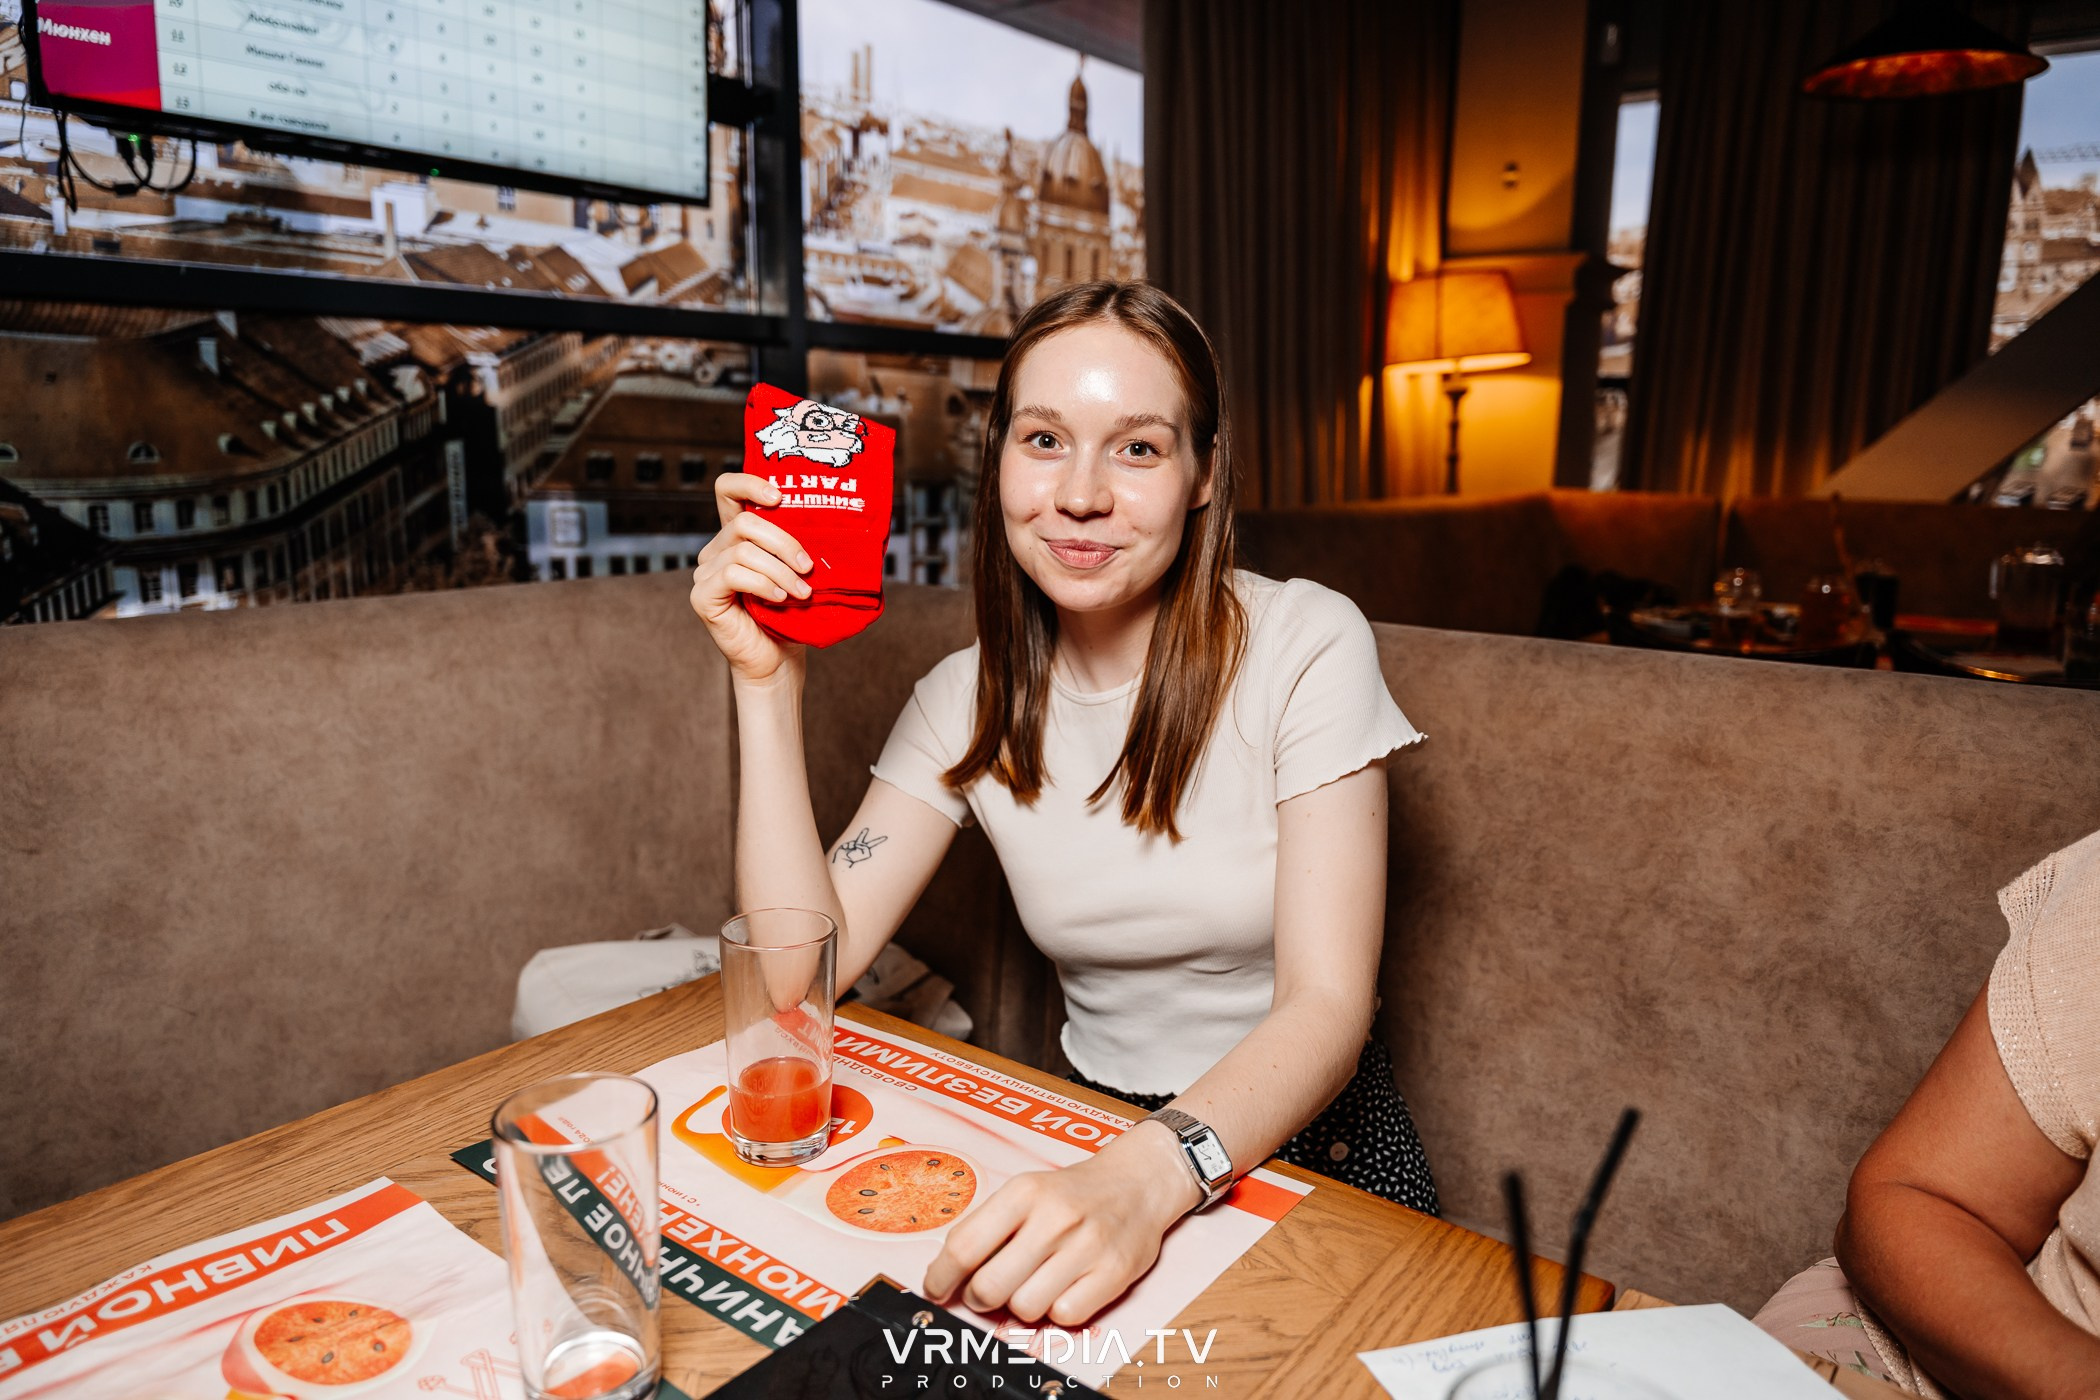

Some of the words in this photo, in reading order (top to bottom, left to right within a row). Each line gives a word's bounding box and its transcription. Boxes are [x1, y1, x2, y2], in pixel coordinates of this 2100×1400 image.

[37, 16, 112, 46] Мюнхен
[768, 475, 857, 492] PARTY
[834, 1030, 1032, 1115] БЕЗЛИМИ
[930, 1051, 991, 1077] СУББОТУ
[990, 1072, 1002, 1081] И
[1001, 1076, 1067, 1105] ПЯТНИЦУ
[1067, 1102, 1134, 1130] КАЖДУЮ
[37, 1218, 351, 1352] ПИВНОЙ
[43, 1265, 153, 1320] КАЖДУЮ
[0, 1318, 37, 1339] ПЯ
